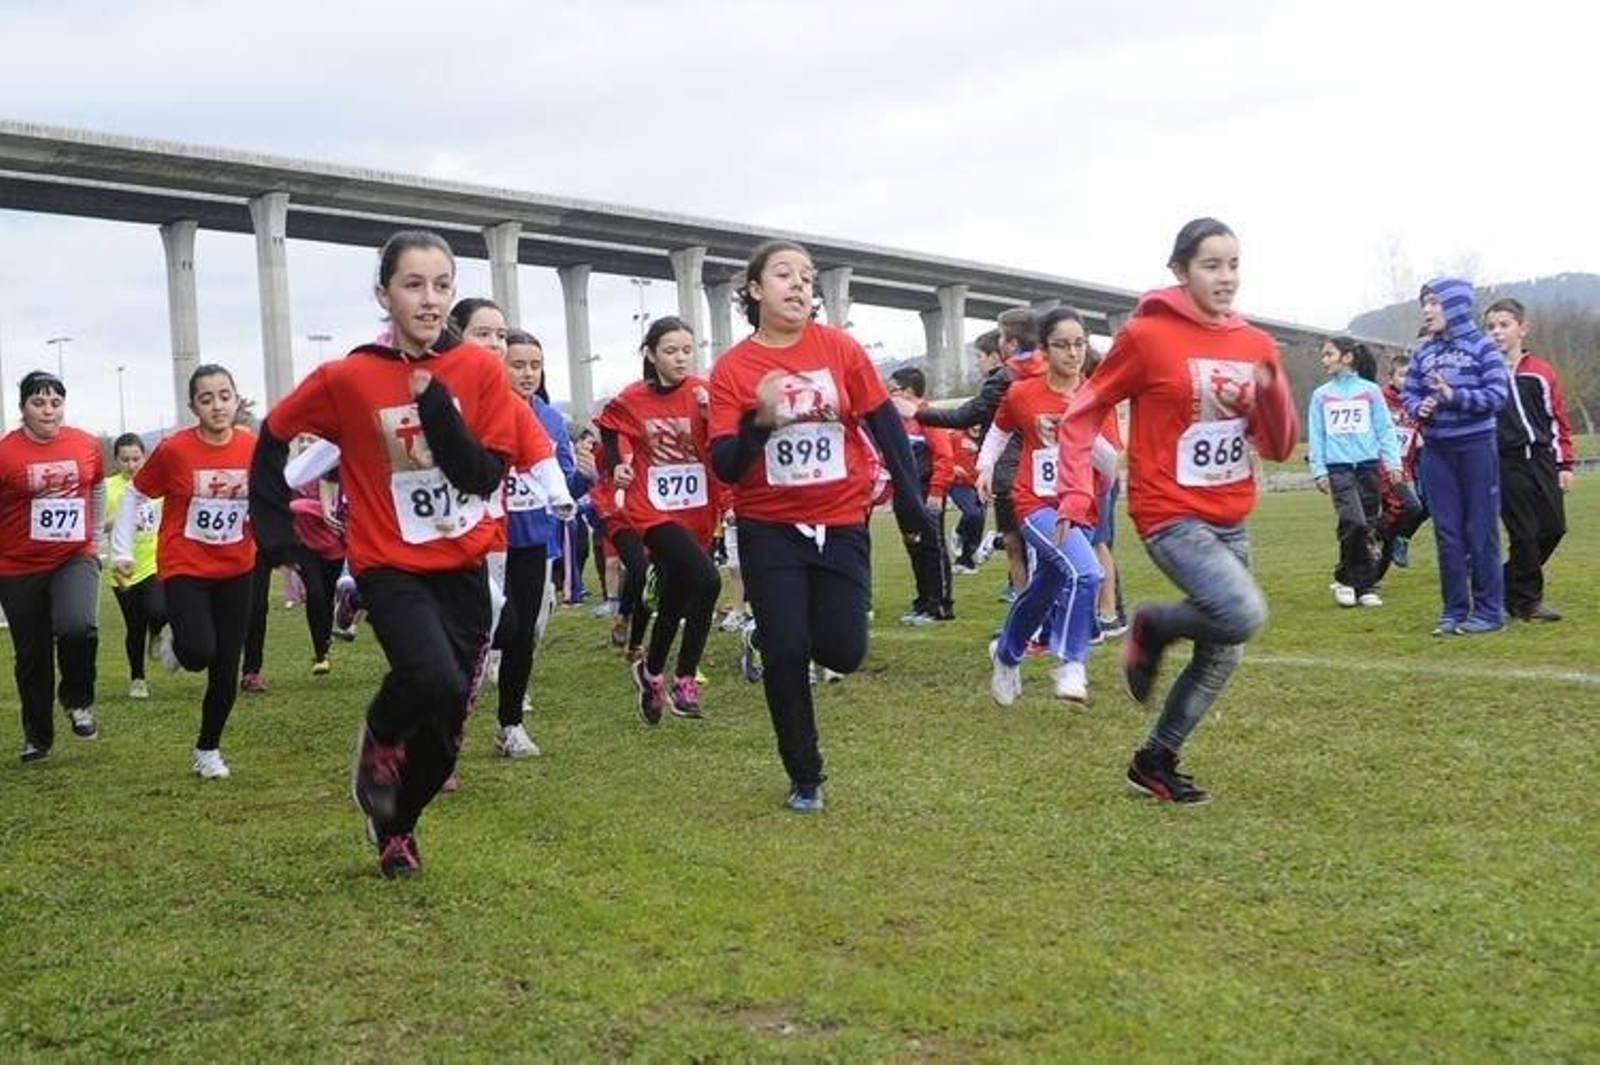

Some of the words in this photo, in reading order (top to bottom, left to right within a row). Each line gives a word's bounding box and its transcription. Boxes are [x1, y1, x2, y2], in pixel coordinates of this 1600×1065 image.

[1330, 408, 1362, 425] 775
[776, 436, 831, 466] 898
[1193, 436, 1244, 467] 868
[657, 475, 698, 497] 870
[39, 509, 79, 529] 877
[197, 510, 238, 530] 869
